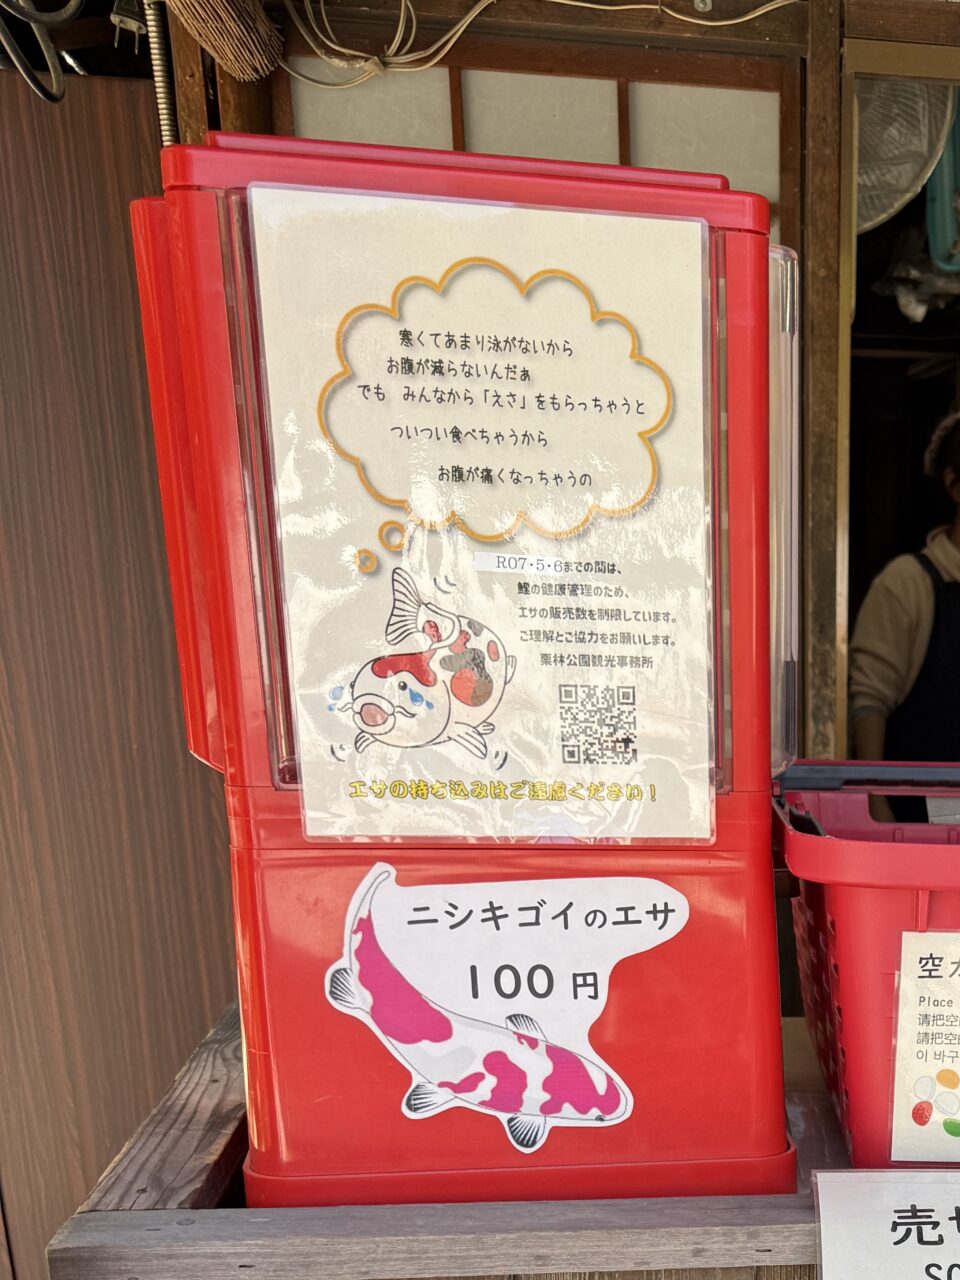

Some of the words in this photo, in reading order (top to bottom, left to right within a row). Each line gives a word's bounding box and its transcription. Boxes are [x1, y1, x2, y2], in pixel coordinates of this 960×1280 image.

[399, 329, 573, 357] 寒くてあまり泳がないから
[387, 357, 531, 382] お腹が減らないんだぁ
[357, 383, 386, 402] でも
[402, 386, 645, 415] みんなから「えさ」をもらっちゃうと
[390, 424, 549, 447] ついつい食べちゃうから
[438, 465, 592, 488] お腹が痛くなっちゃうの
[517, 581, 630, 599] 鯉の健康管理のため、
[518, 606, 677, 624] エサの販売数を制限しています。
[520, 629, 676, 647] ご理解とご協力をお願いします。
[540, 653, 654, 669] 栗林公園観光事務所
[406, 899, 676, 931] ニシキゴイのエサ
[918, 996, 954, 1008] Place
[916, 1049, 929, 1063] 이
